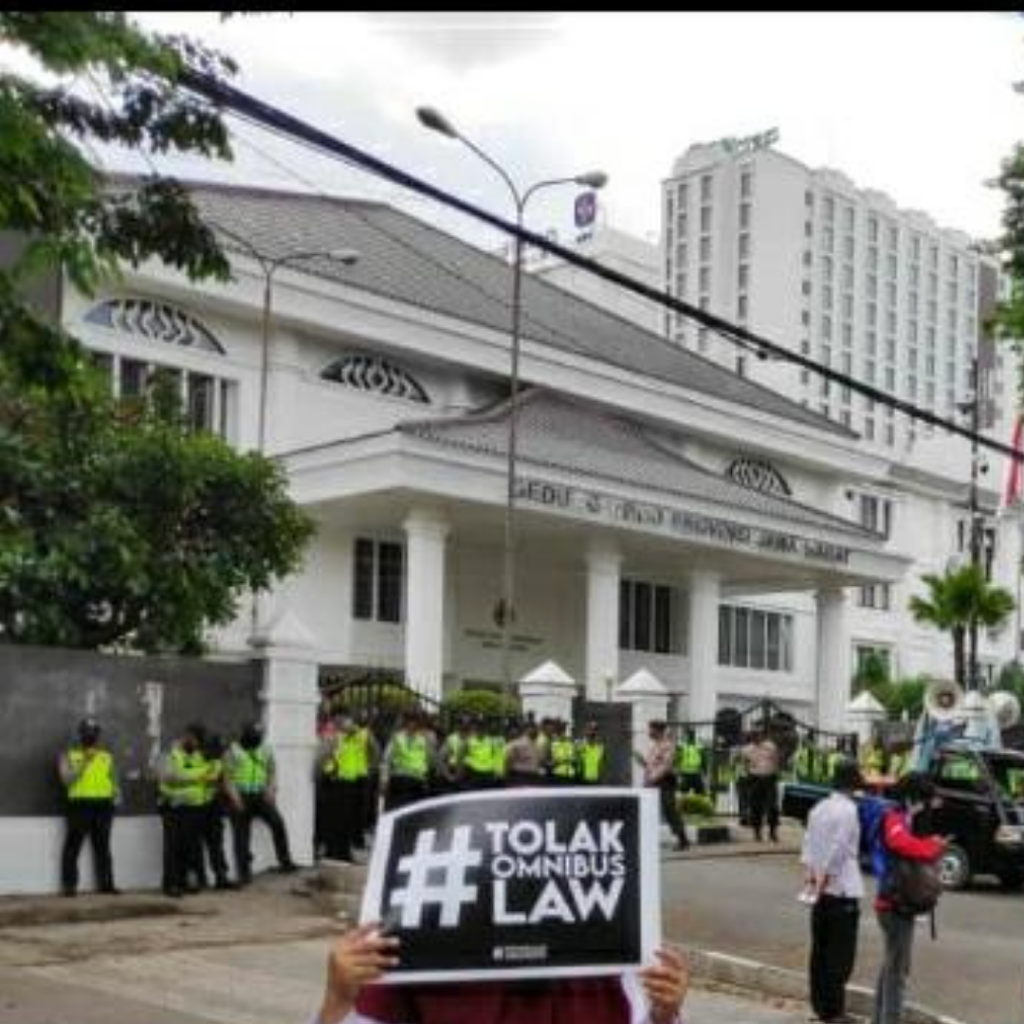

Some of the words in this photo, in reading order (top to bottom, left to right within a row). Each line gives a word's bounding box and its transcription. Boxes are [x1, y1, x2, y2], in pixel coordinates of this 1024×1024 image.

[485, 819, 627, 855] TOLAK
[490, 853, 628, 879] OMNIBUS
[492, 877, 627, 925] LAW
